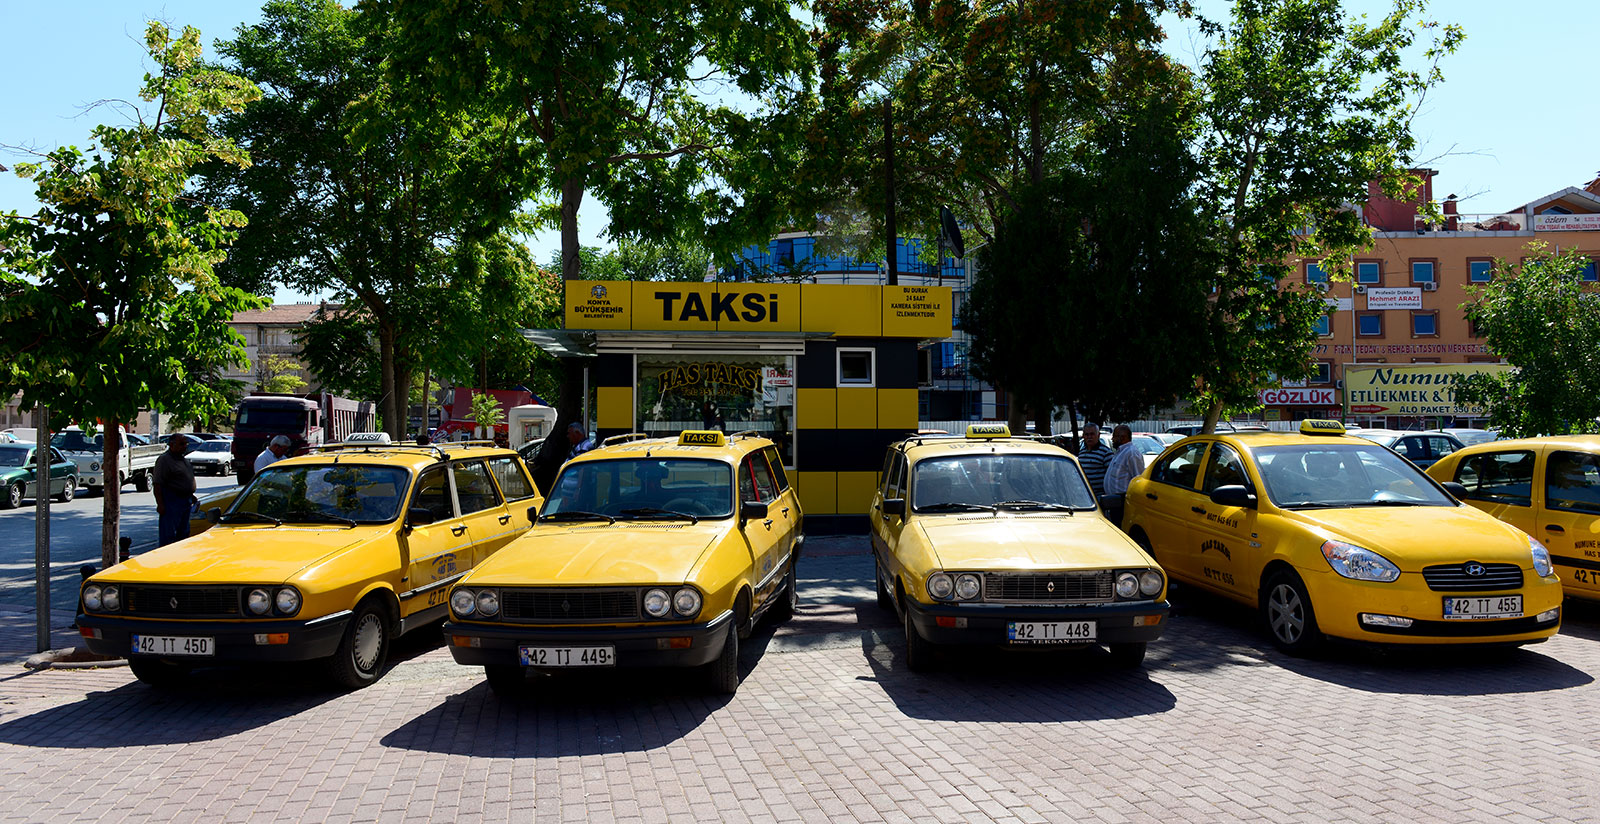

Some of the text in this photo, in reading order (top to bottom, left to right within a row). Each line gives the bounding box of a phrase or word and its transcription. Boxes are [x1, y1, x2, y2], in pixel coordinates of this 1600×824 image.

[574, 305, 624, 313] BÜYÜKŞEHİR
[658, 363, 700, 393] HAS
[1264, 390, 1334, 405] GÖZLÜK
[1350, 387, 1429, 403] ETLİEKMEK
[1432, 390, 1444, 403] &
[1420, 405, 1450, 413] PAKET
[1453, 405, 1469, 413] 350
[1574, 569, 1588, 583] 42
[428, 591, 437, 605] 42
[1454, 599, 1470, 613] 42
[1477, 599, 1491, 613] TT
[1497, 597, 1517, 612] 455
[1018, 622, 1090, 638] 42 TT 448
[141, 637, 207, 653] 42 TT 450
[530, 649, 547, 664] 42
[581, 648, 607, 664] 449
